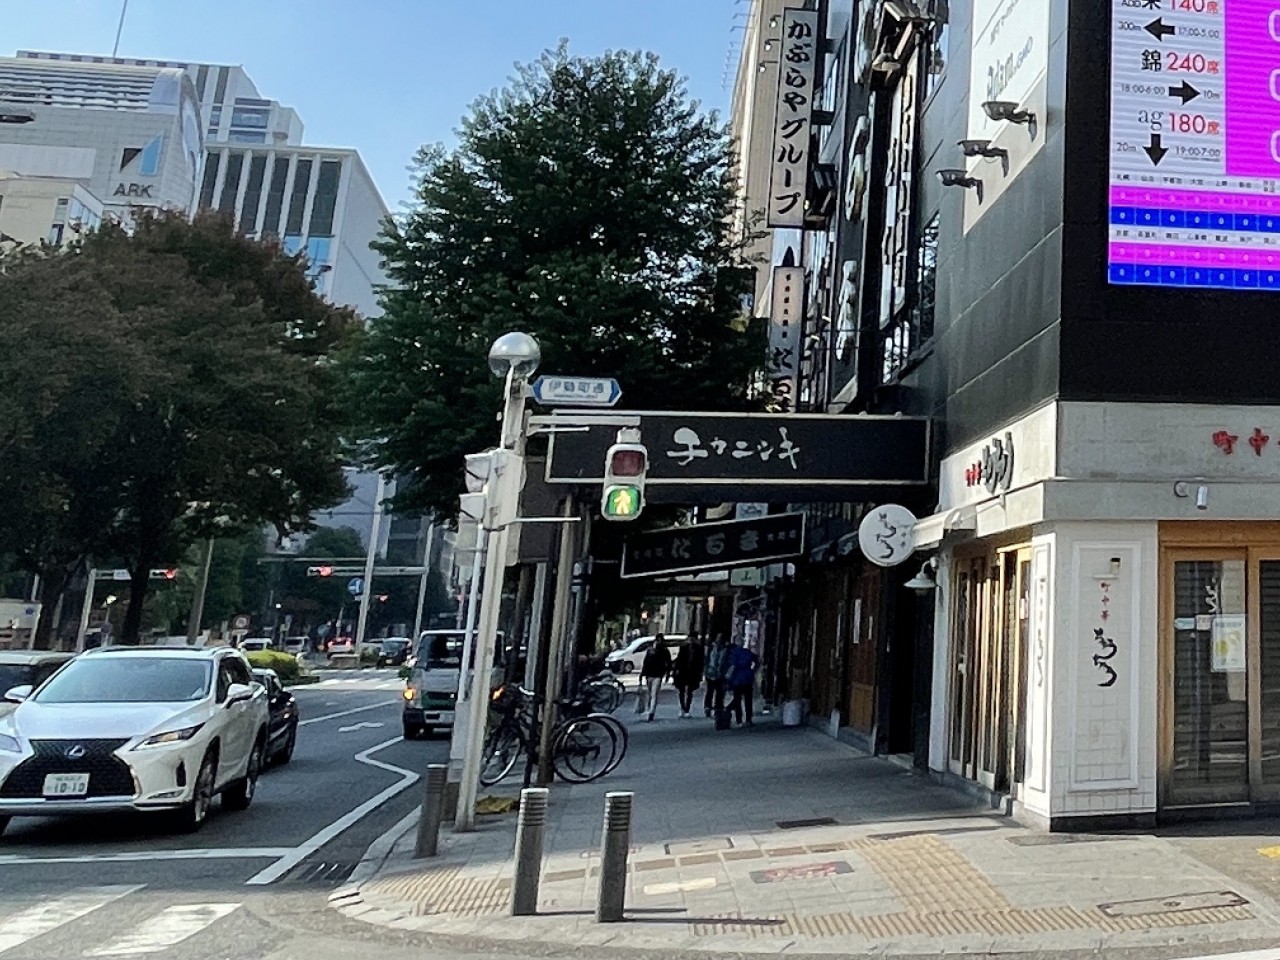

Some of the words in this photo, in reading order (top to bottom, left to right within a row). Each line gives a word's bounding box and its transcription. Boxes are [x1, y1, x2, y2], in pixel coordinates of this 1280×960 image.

[1141, 49, 1162, 72] 錦
[774, 19, 813, 217] かぶらやグループ
[1137, 109, 1164, 131] ag
[113, 183, 154, 197] ARK
[666, 426, 800, 470] チカニシキ
